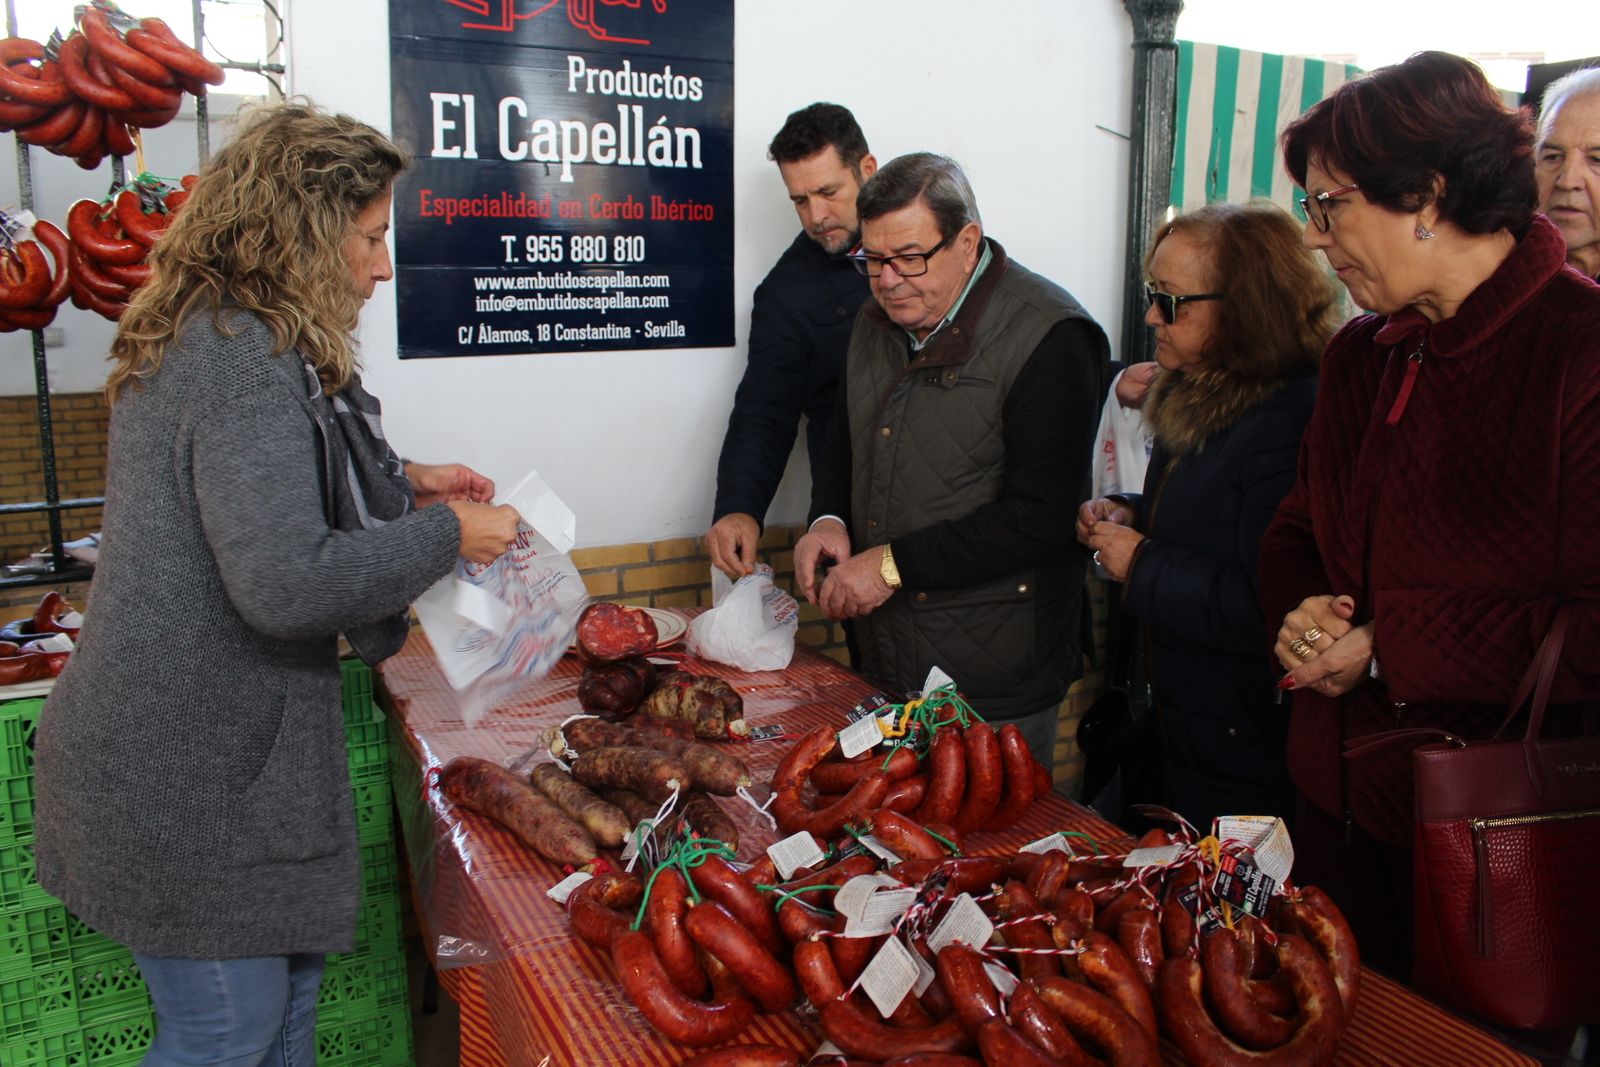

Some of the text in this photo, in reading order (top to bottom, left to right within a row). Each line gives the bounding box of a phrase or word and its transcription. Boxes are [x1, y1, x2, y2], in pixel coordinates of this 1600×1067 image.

[567, 55, 703, 101] Productos
[430, 92, 703, 183] El Capellán
[419, 189, 714, 225] Especialidad en Cerdo Ibérico
[501, 235, 645, 263] T. 955 880 810
[474, 271, 670, 293] www.embutidoscapellan.com
[475, 291, 669, 314] info@embutidoscapellan.com
[458, 326, 473, 344] C/
[477, 323, 533, 344] Álamos,
[536, 323, 551, 341] 18
[554, 322, 631, 341] Constantina
[644, 320, 686, 338] Sevilla
